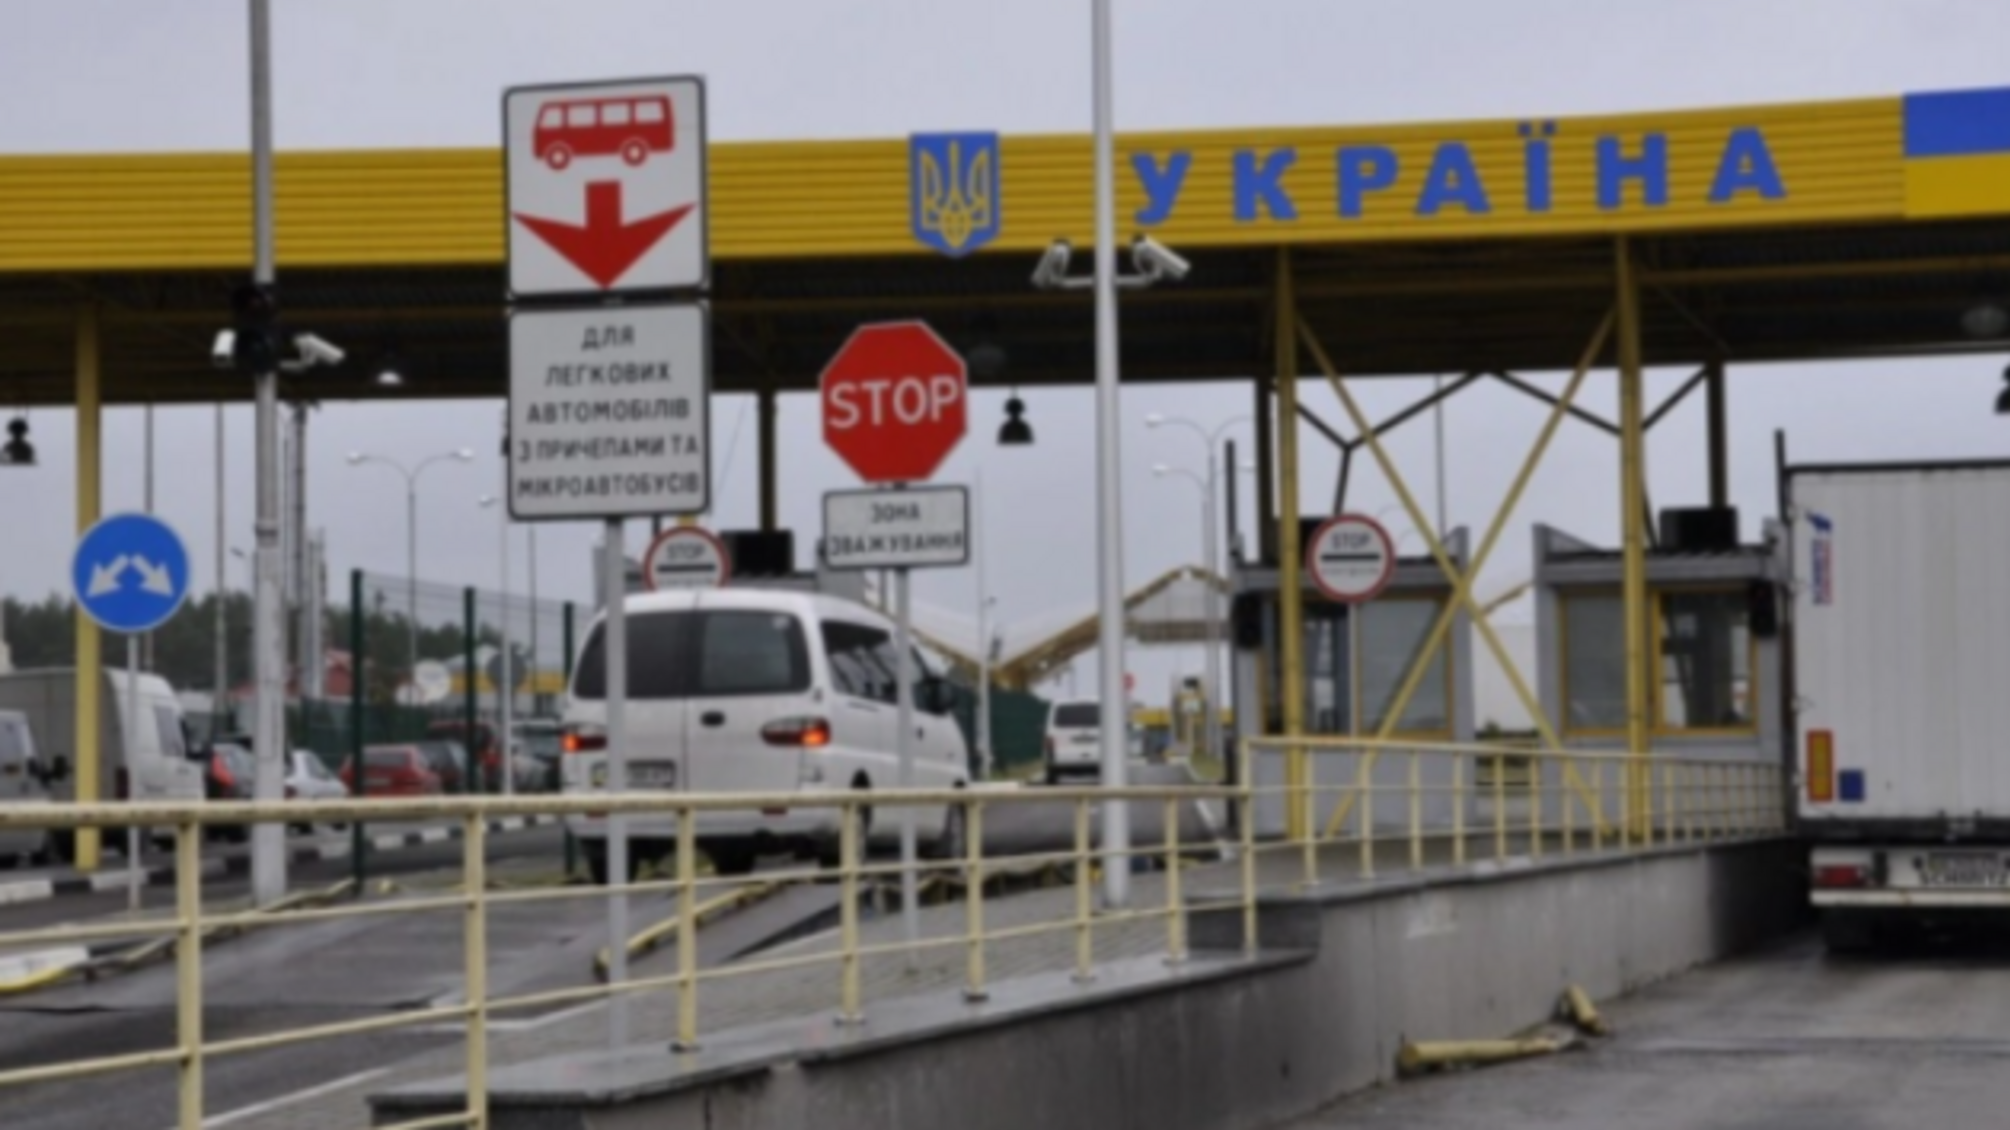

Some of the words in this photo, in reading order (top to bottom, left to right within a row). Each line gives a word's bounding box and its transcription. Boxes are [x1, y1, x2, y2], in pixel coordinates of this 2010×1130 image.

[1130, 120, 1788, 226] УКРАЇНА
[581, 324, 636, 351] ДЛЯ
[546, 362, 671, 387] ЛЕГКОВИХ
[526, 397, 691, 424] АВТОМОБІЛІВ
[828, 375, 960, 429] STOP
[536, 434, 666, 461] ПРИЧЕПАМИ
[671, 432, 699, 455] ТА
[517, 470, 700, 498] МІКРОАВТОБУСІВ
[871, 501, 921, 524] ЗОНА
[666, 543, 706, 561] STOP
[1331, 532, 1371, 550] STOP
